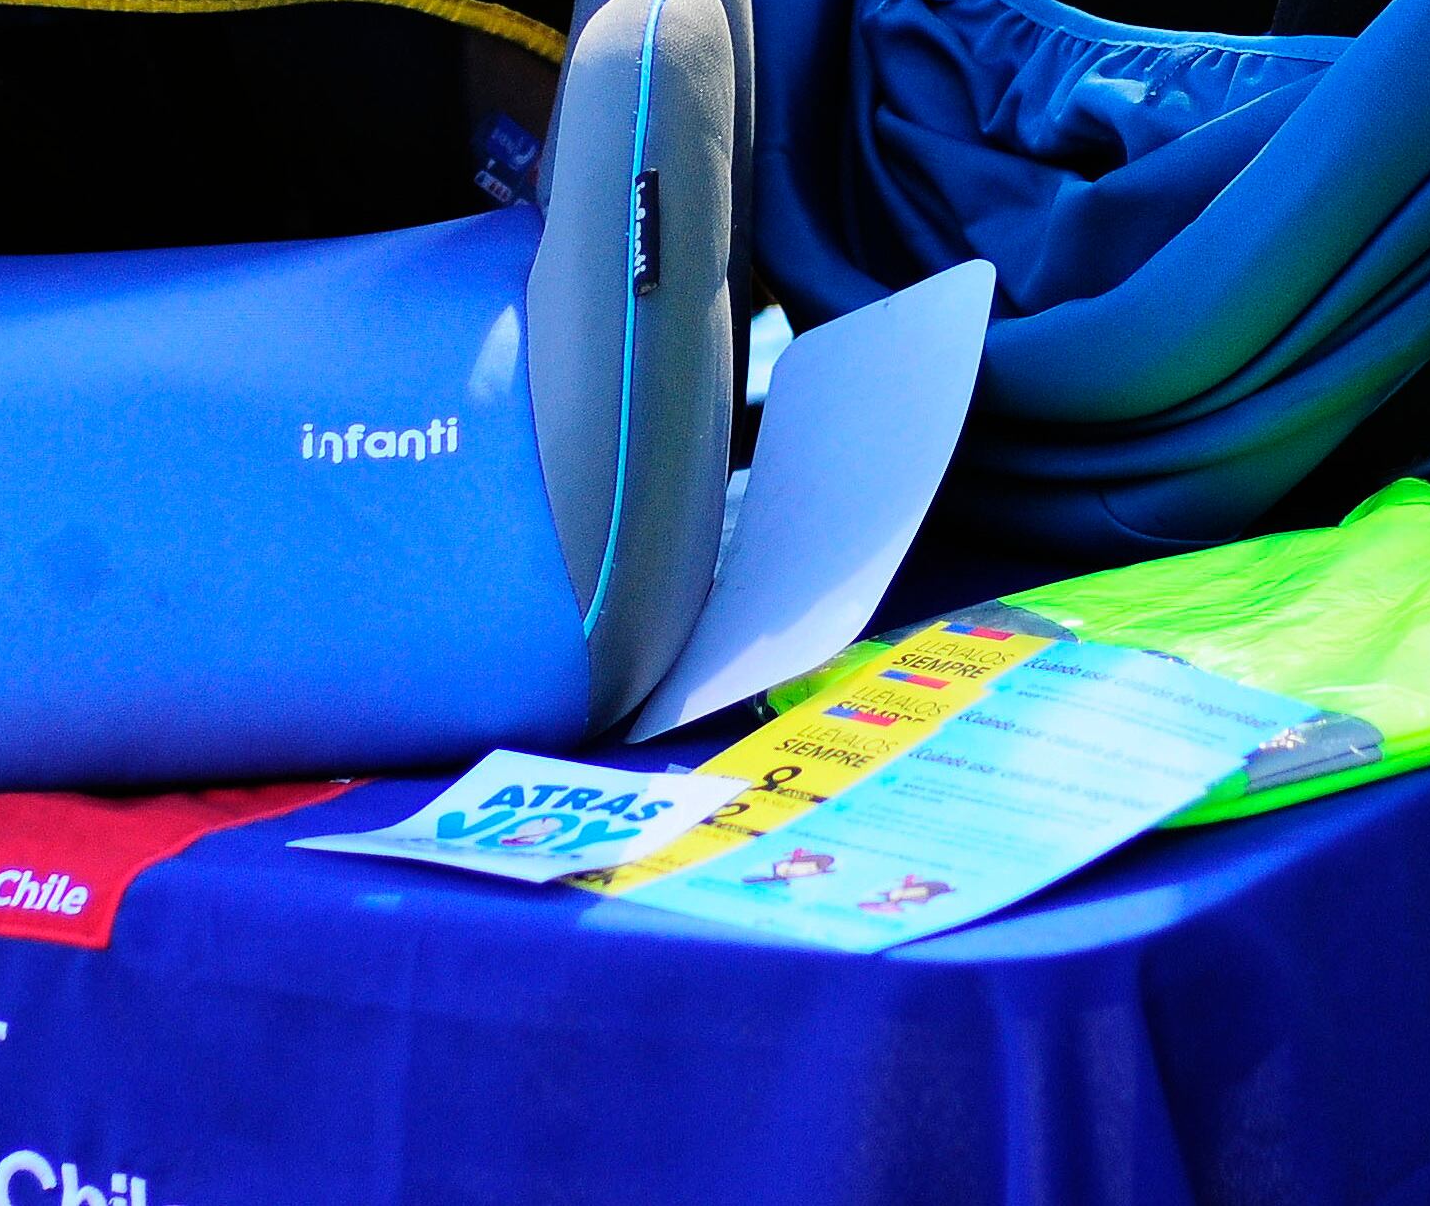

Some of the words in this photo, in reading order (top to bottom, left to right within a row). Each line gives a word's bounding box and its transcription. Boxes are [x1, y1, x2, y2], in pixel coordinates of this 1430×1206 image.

[302, 417, 459, 464] infanti
[891, 653, 991, 679] SIEMPRE
[774, 738, 876, 769] SIEMPRE
[478, 784, 674, 823] ATRAS
[435, 809, 643, 853] VOY
